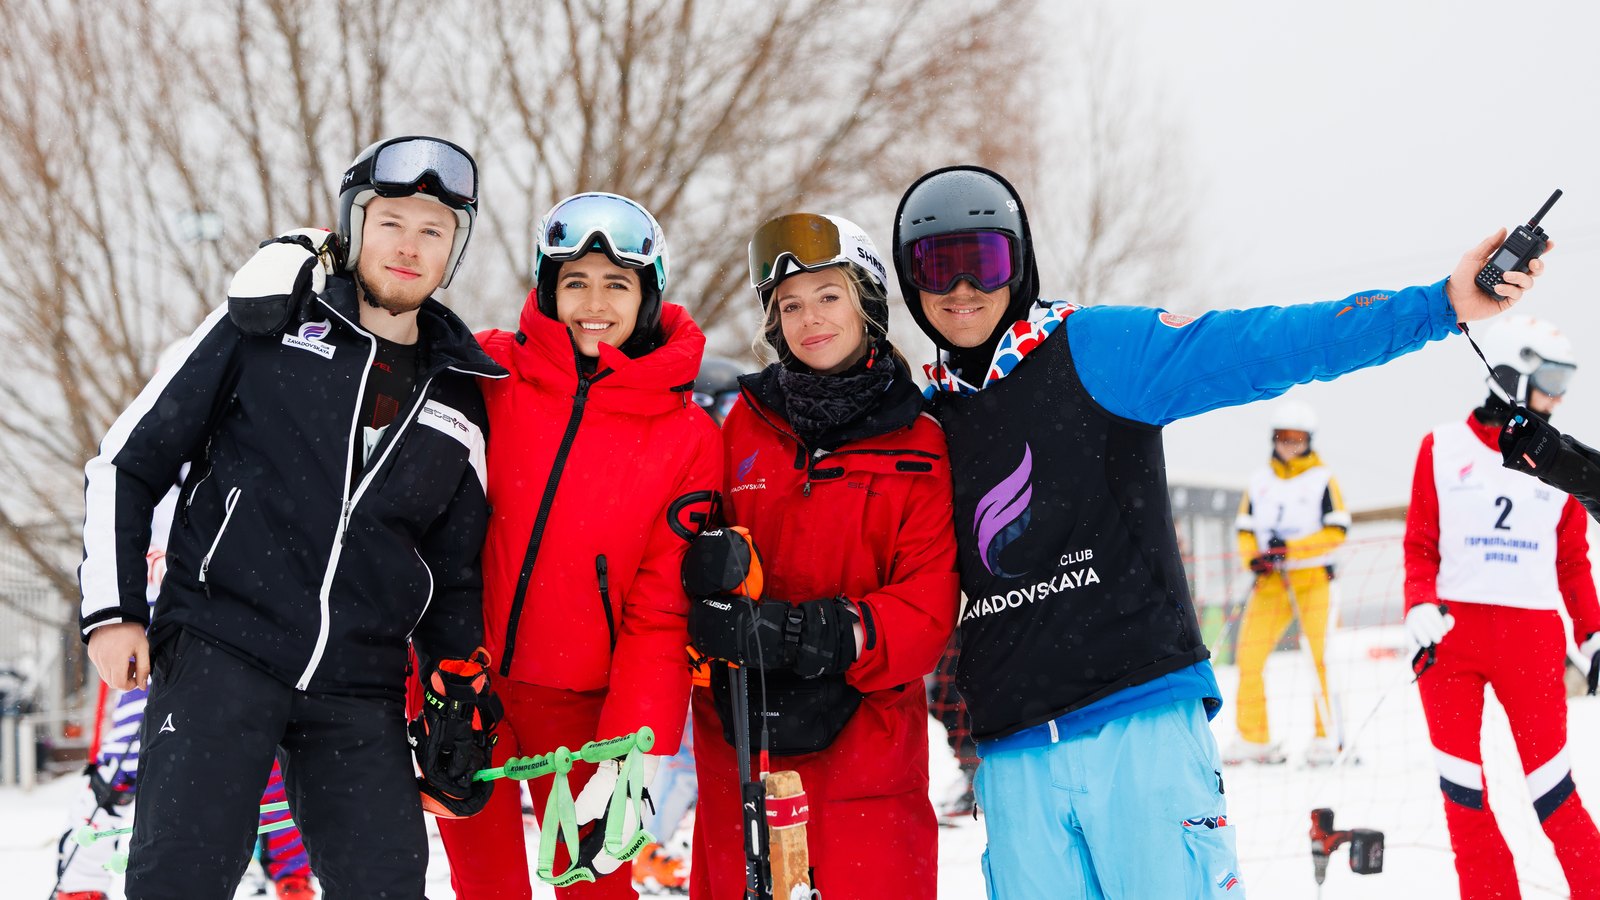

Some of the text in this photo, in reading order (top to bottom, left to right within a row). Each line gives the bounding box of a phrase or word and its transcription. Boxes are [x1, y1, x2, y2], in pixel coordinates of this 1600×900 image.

[1494, 496, 1513, 530] 2
[963, 567, 1100, 621] AVADOVSKAYA
[510, 759, 549, 773] KOMPERDELL
[618, 836, 645, 861] KOMPER
